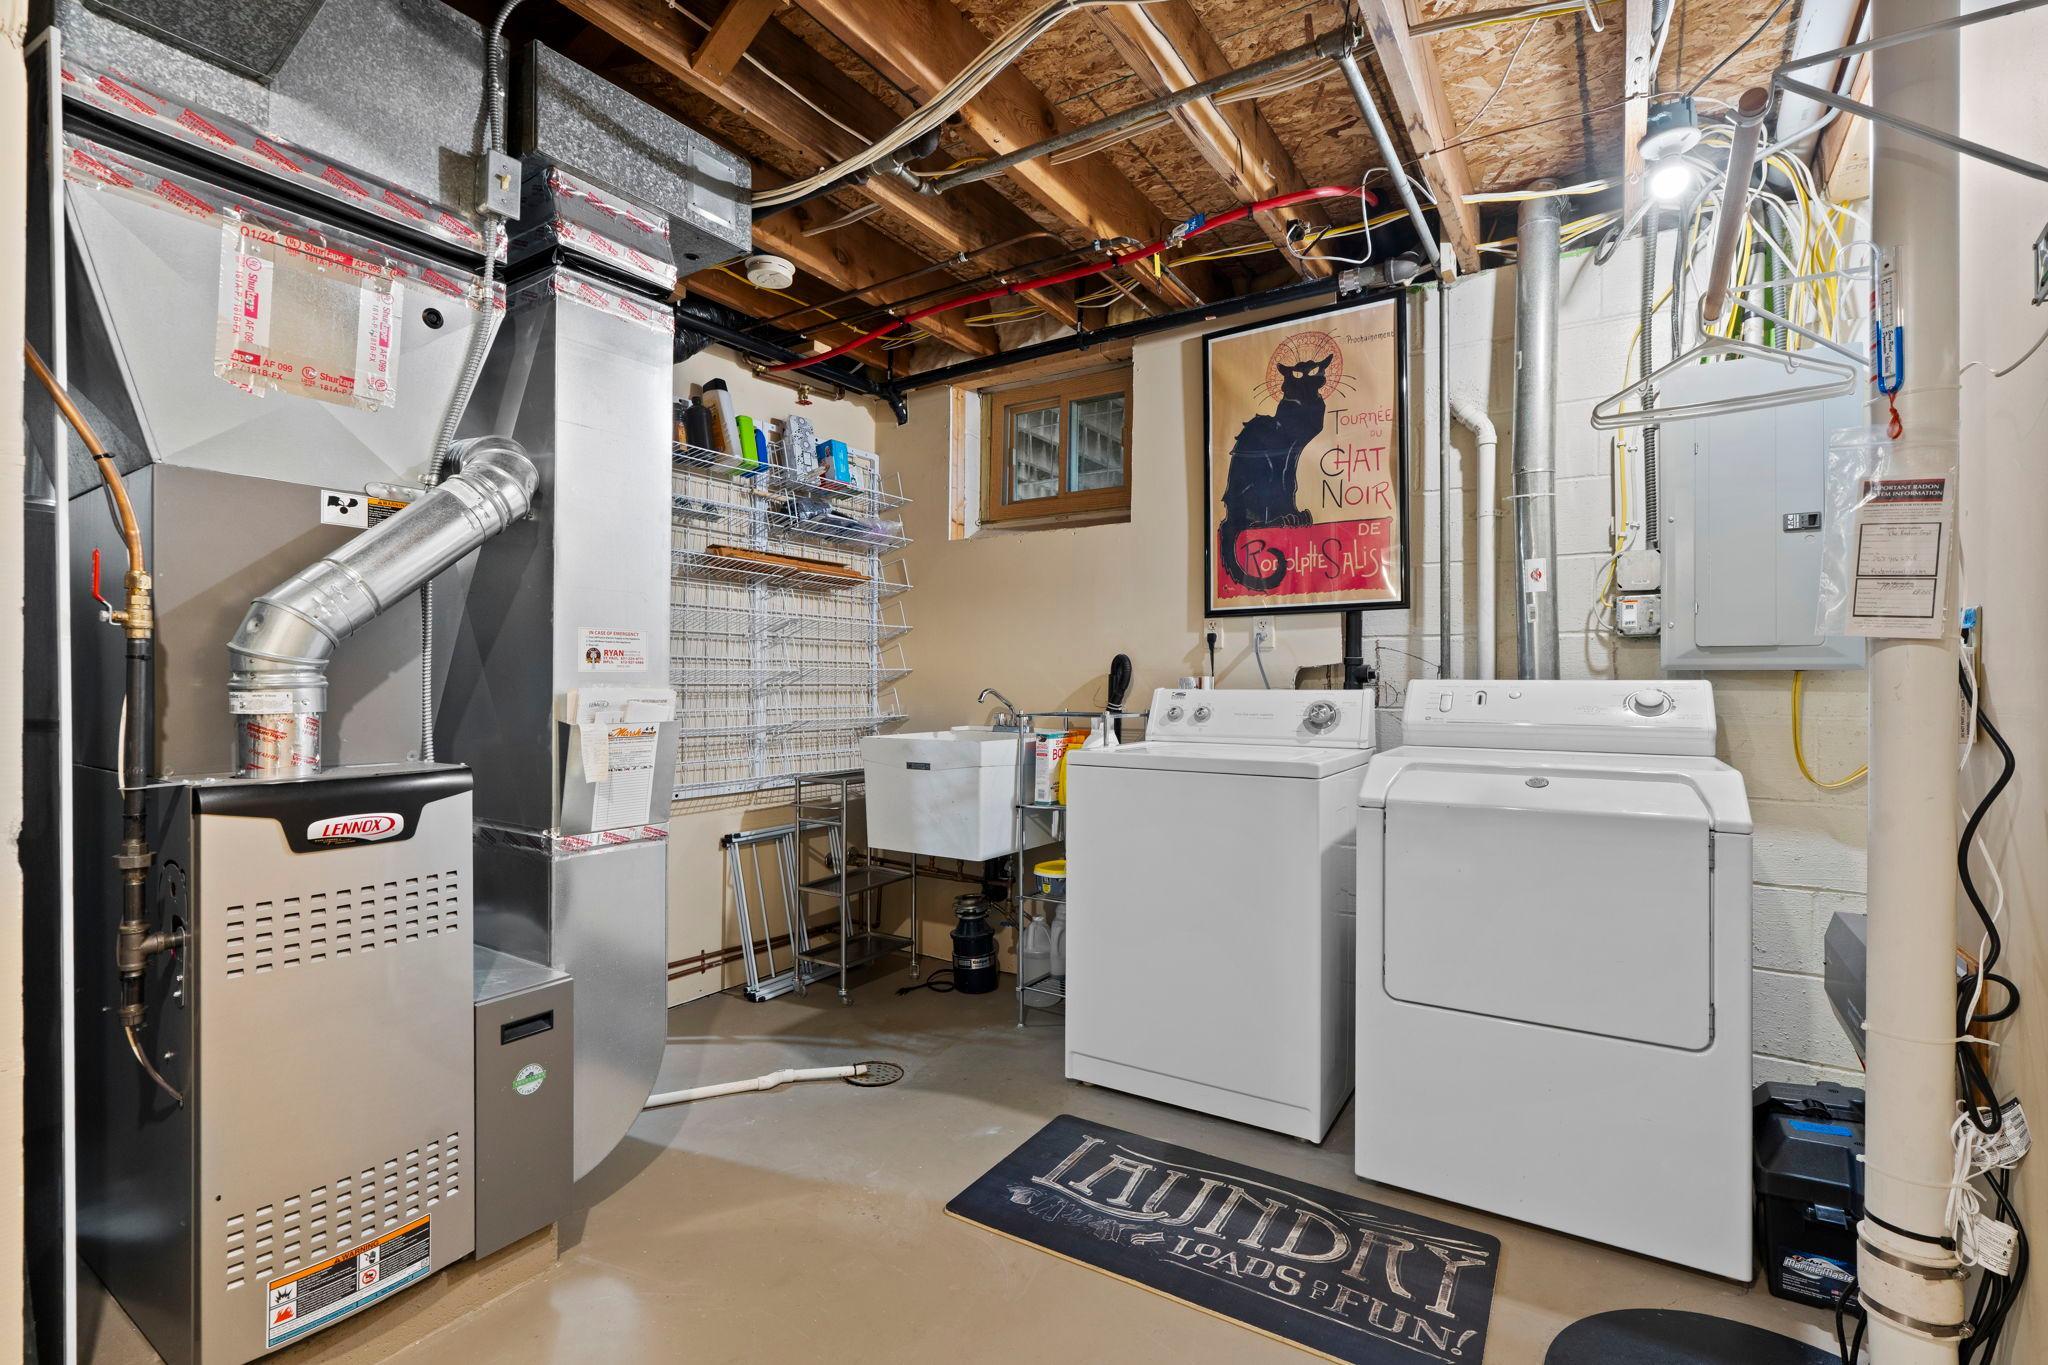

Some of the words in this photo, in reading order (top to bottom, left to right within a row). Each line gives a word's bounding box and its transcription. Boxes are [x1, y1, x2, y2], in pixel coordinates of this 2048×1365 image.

[240, 226, 276, 243] Q1/24
[304, 243, 346, 262] Shurtape
[262, 359, 276, 369] AF
[277, 362, 293, 373] 099
[1320, 444, 1386, 482] CHAT
[1322, 479, 1392, 510] NOIR
[1358, 523, 1381, 536] DE
[603, 649, 625, 657] RYAN
[321, 818, 383, 837] LENNOX
[1032, 1133, 1488, 1319] LAUNDRY
[338, 1239, 380, 1263] WARNING
[1821, 1265, 1856, 1283] Maste
[1167, 1235, 1305, 1298] LOADS
[1324, 1281, 1478, 1357] FUN!
